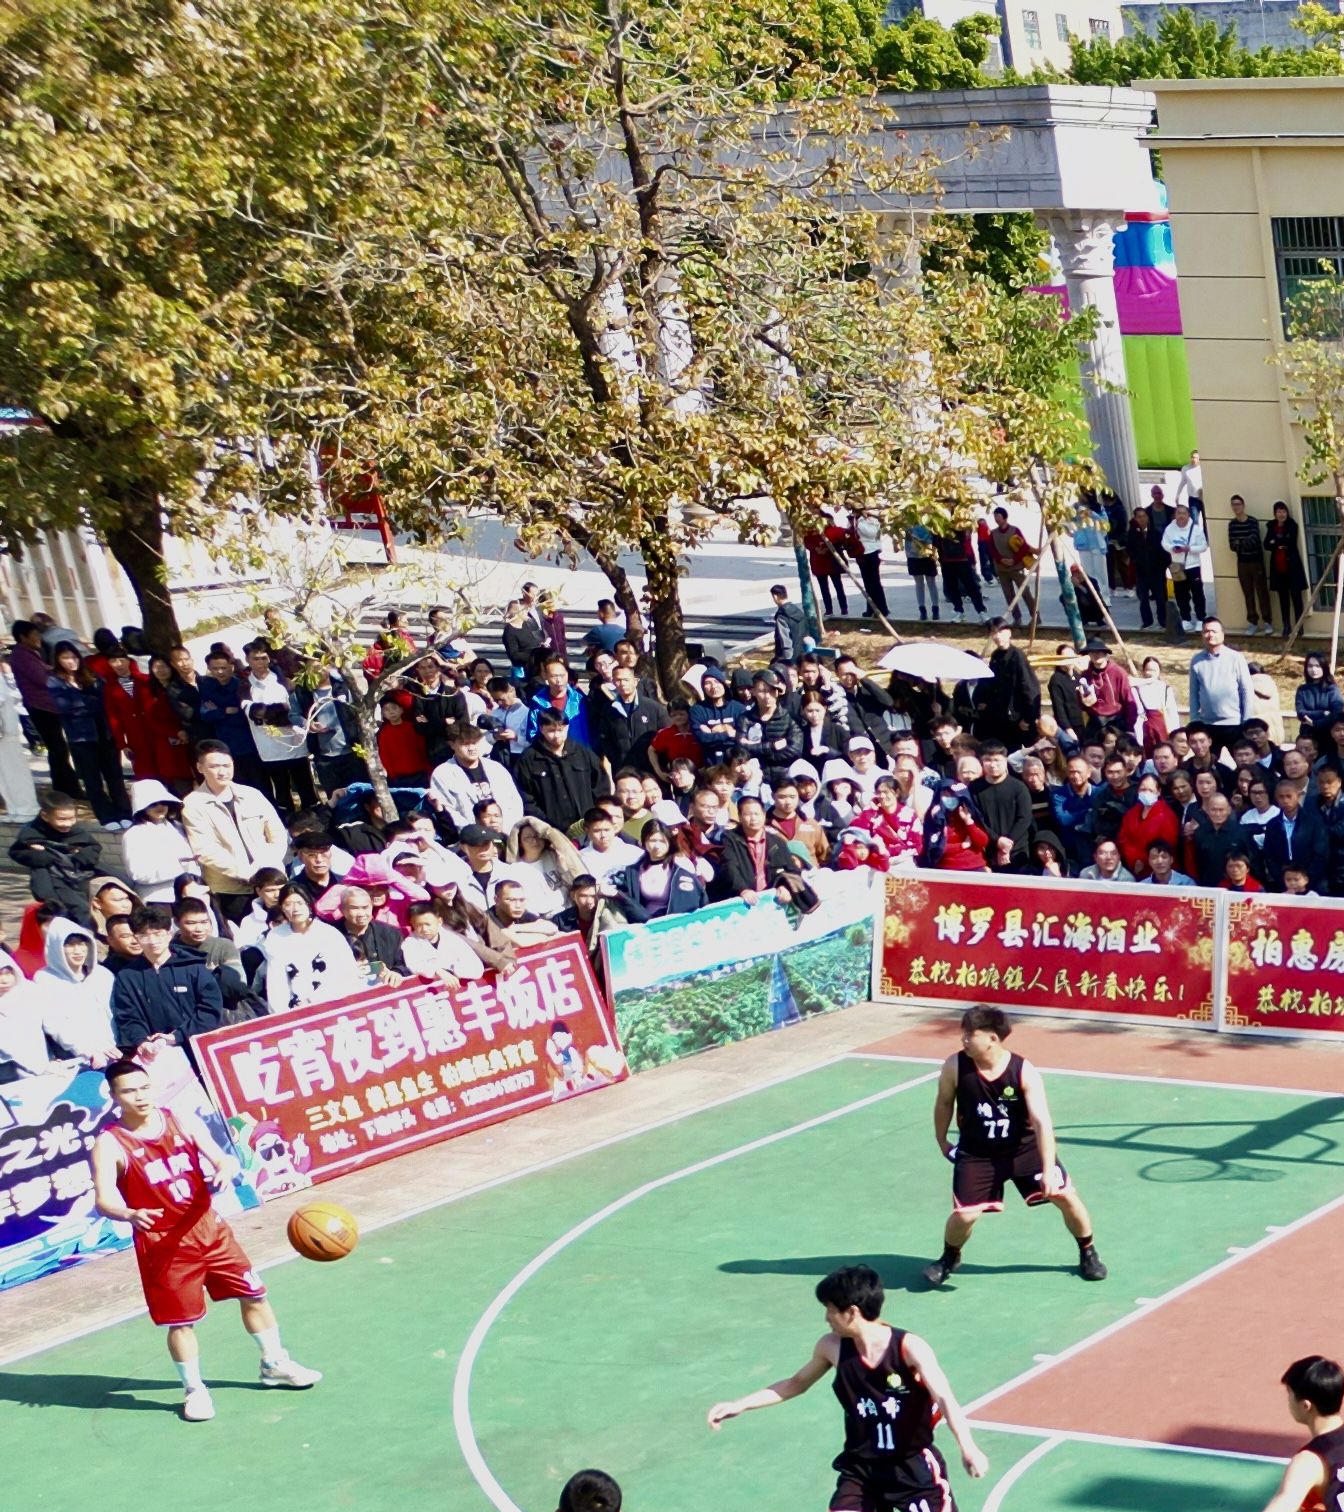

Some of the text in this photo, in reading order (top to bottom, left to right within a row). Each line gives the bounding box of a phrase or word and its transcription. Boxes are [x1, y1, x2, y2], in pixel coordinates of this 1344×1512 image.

[934, 903, 1161, 953] 博罗县汇海酒业
[231, 957, 583, 1104] 吃宵夜到惠丰饭店
[983, 1119, 1011, 1139] 77
[876, 1422, 895, 1450] 11
